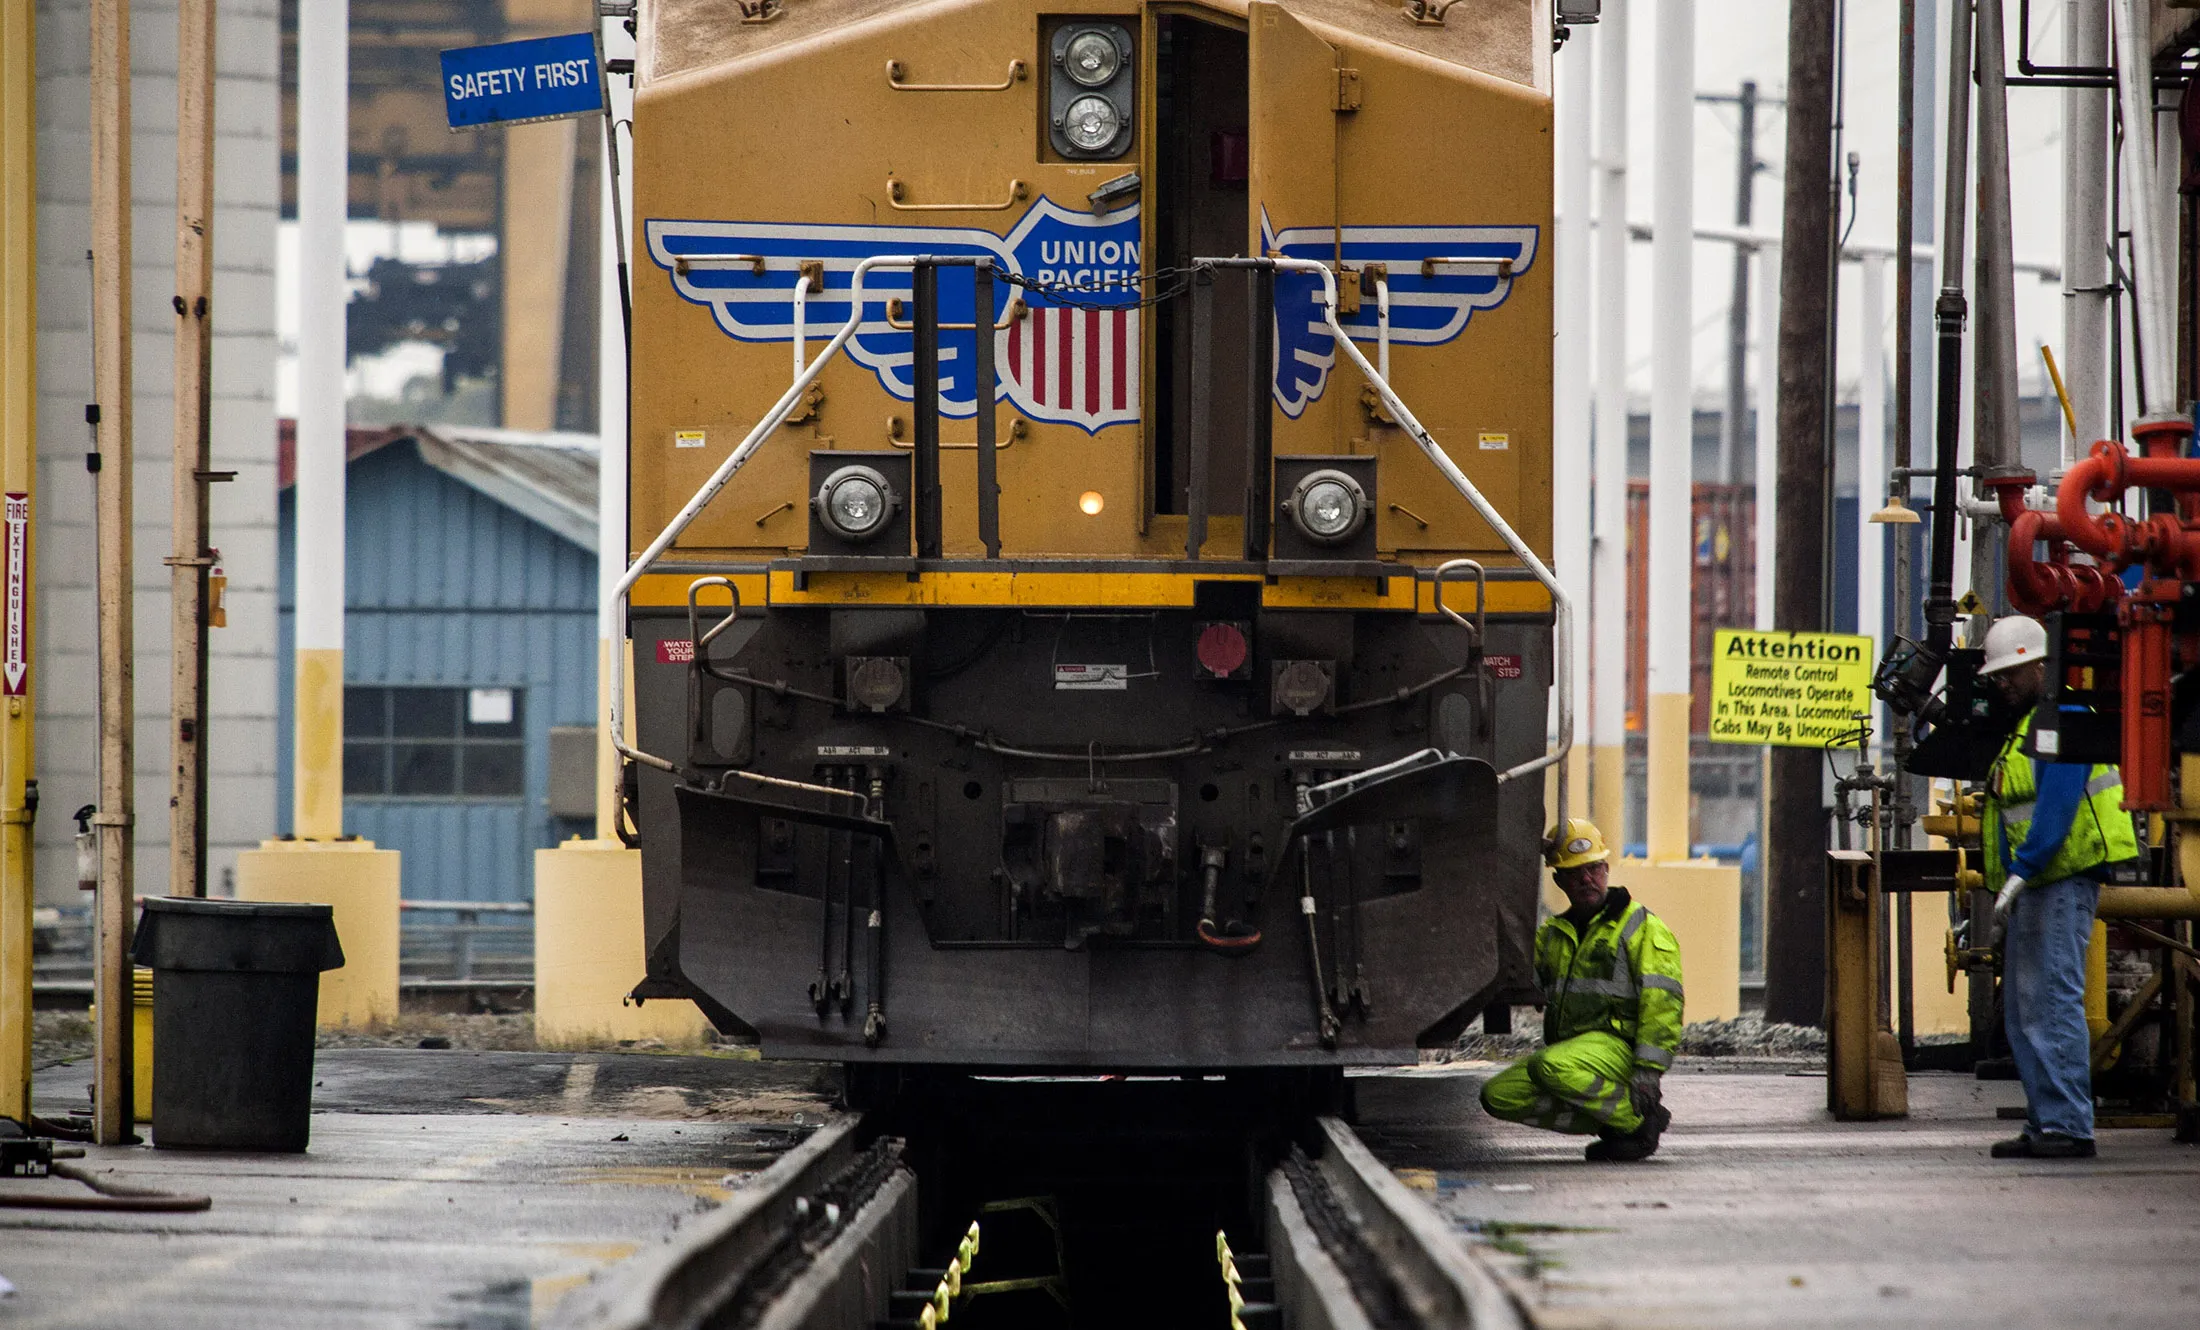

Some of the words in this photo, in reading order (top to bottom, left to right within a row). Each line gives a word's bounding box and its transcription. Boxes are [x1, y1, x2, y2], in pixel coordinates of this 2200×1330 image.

[450, 66, 526, 101] SAFETY
[534, 58, 590, 90] FIRST
[1041, 240, 1141, 265] UNION
[1038, 268, 1141, 293] PACIFIC
[6, 503, 28, 520] FIRE
[11, 523, 20, 673] EXTINGUISHER
[663, 640, 693, 648] WATC
[667, 647, 694, 655] YOUR
[1727, 636, 1861, 661] Attention
[1498, 667, 1521, 677] STEP
[1746, 664, 1790, 680] Remote
[1795, 665, 1838, 682] Control
[1728, 682, 1802, 700] Locomotives
[1807, 685, 1854, 702] Operate
[1718, 701, 1729, 715] In
[1734, 700, 1755, 716] This
[1760, 703, 1790, 717] Area.
[1713, 719, 1741, 734] Cabs
[1747, 720, 1773, 740] May
[1777, 721, 1791, 737] Be
